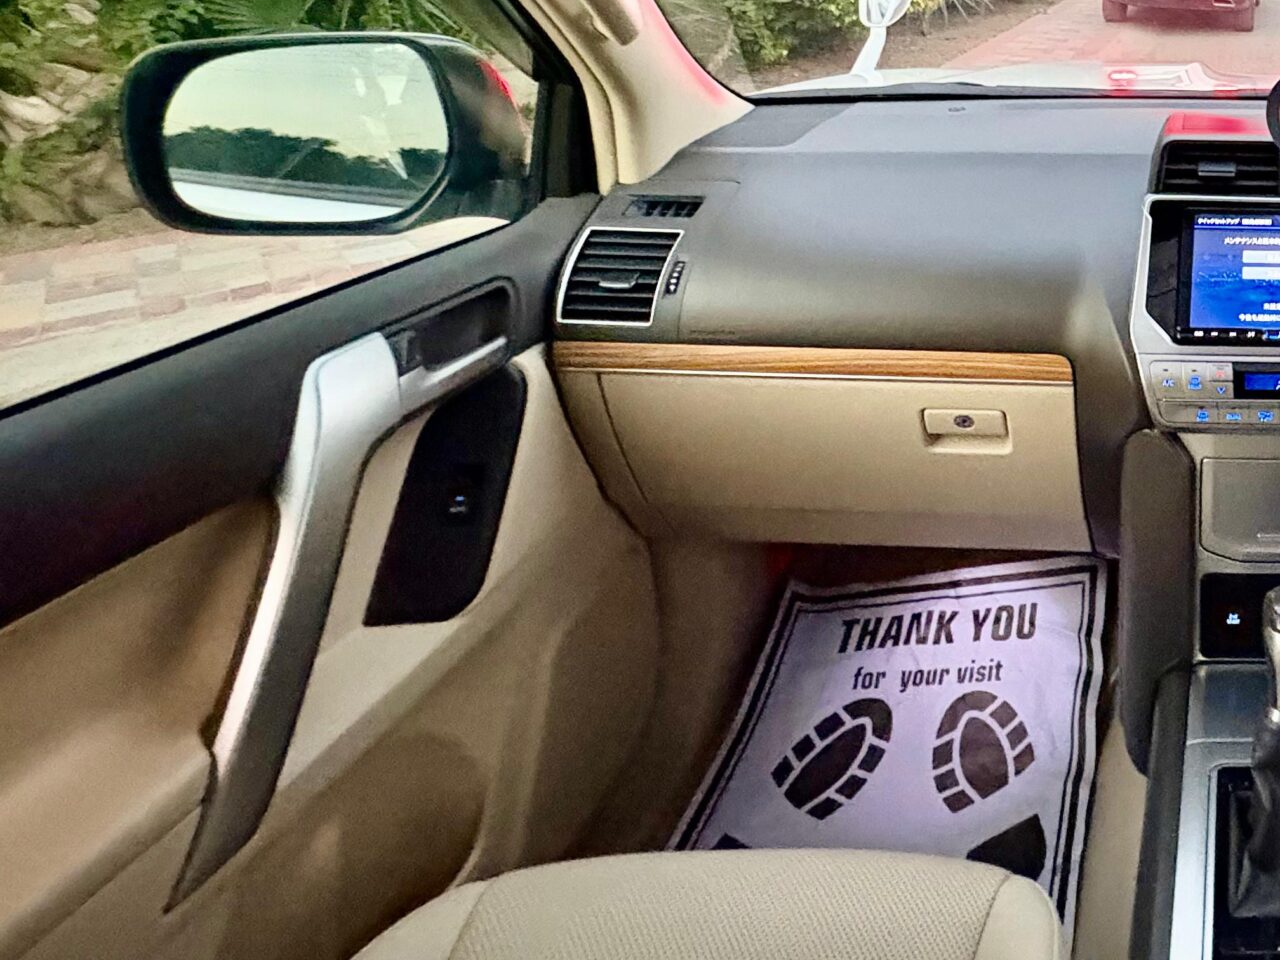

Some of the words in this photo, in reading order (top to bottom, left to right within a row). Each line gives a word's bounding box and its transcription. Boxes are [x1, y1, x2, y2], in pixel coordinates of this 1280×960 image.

[1161, 379, 1175, 388] A/C
[838, 609, 960, 653] THANK
[971, 602, 1038, 642] YOU
[853, 665, 885, 690] for
[899, 663, 951, 693] your
[956, 658, 1004, 684] visit
